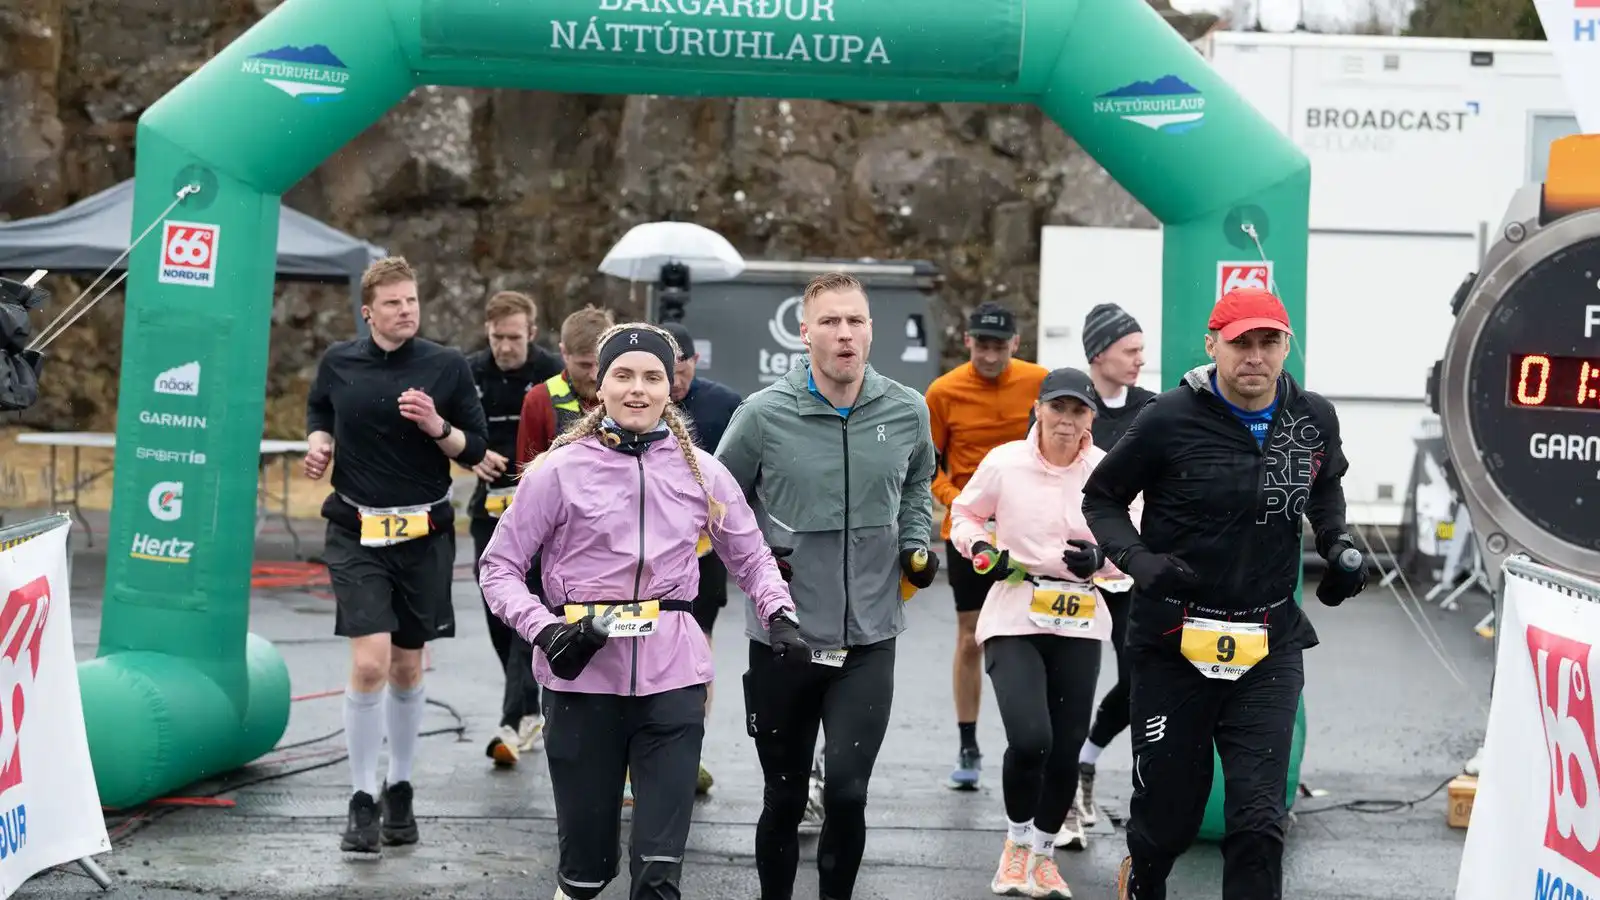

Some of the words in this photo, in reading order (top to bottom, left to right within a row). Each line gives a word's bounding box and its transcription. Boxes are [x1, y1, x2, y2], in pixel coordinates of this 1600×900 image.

[550, 16, 891, 64] NÁTTÚRUHLAUPA
[241, 60, 349, 84] NÁTTÚRUHLAUP
[1093, 97, 1205, 112] NÁTTÚRUHLAUP
[1306, 108, 1467, 132] BROADCAST
[139, 411, 207, 429] GARMIN
[1530, 433, 1600, 461] GARM
[148, 481, 183, 521] G
[381, 518, 408, 537] 12
[132, 533, 194, 558] Hertz
[1052, 594, 1080, 616] 46
[1217, 636, 1236, 663] 9
[1211, 665, 1220, 673] G
[1224, 667, 1246, 675] Hertz
